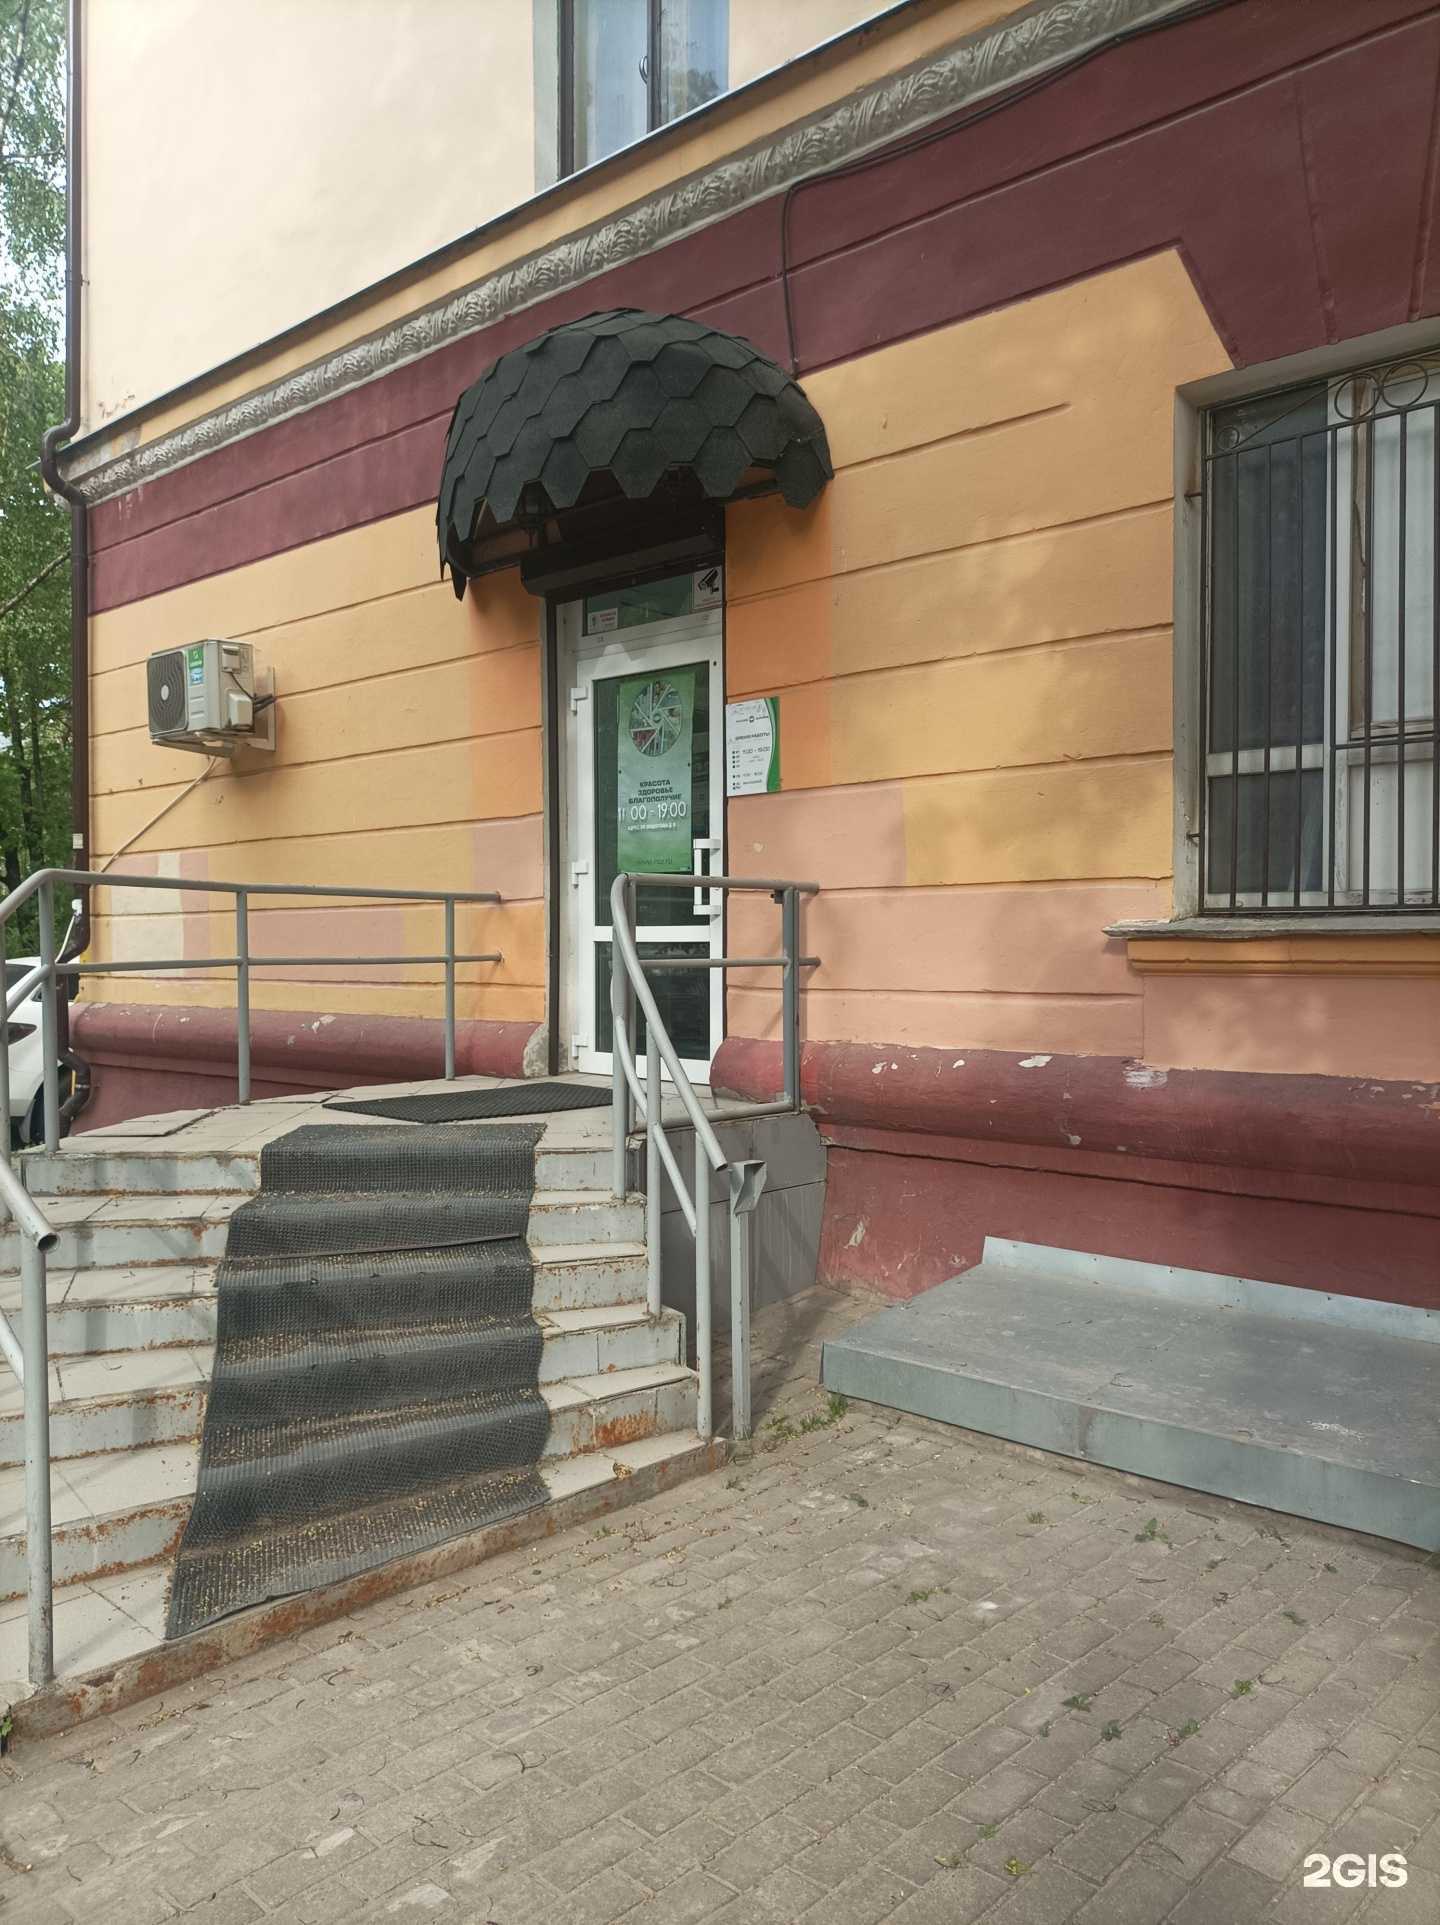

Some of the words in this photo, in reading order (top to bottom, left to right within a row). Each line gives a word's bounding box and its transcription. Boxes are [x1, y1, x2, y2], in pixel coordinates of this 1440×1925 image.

[639, 779, 671, 788] КРАСОТА
[638, 787, 673, 796] ЗДОРОВЬЕ
[628, 794, 682, 804] БЛАГОПОЛУЧИЕ
